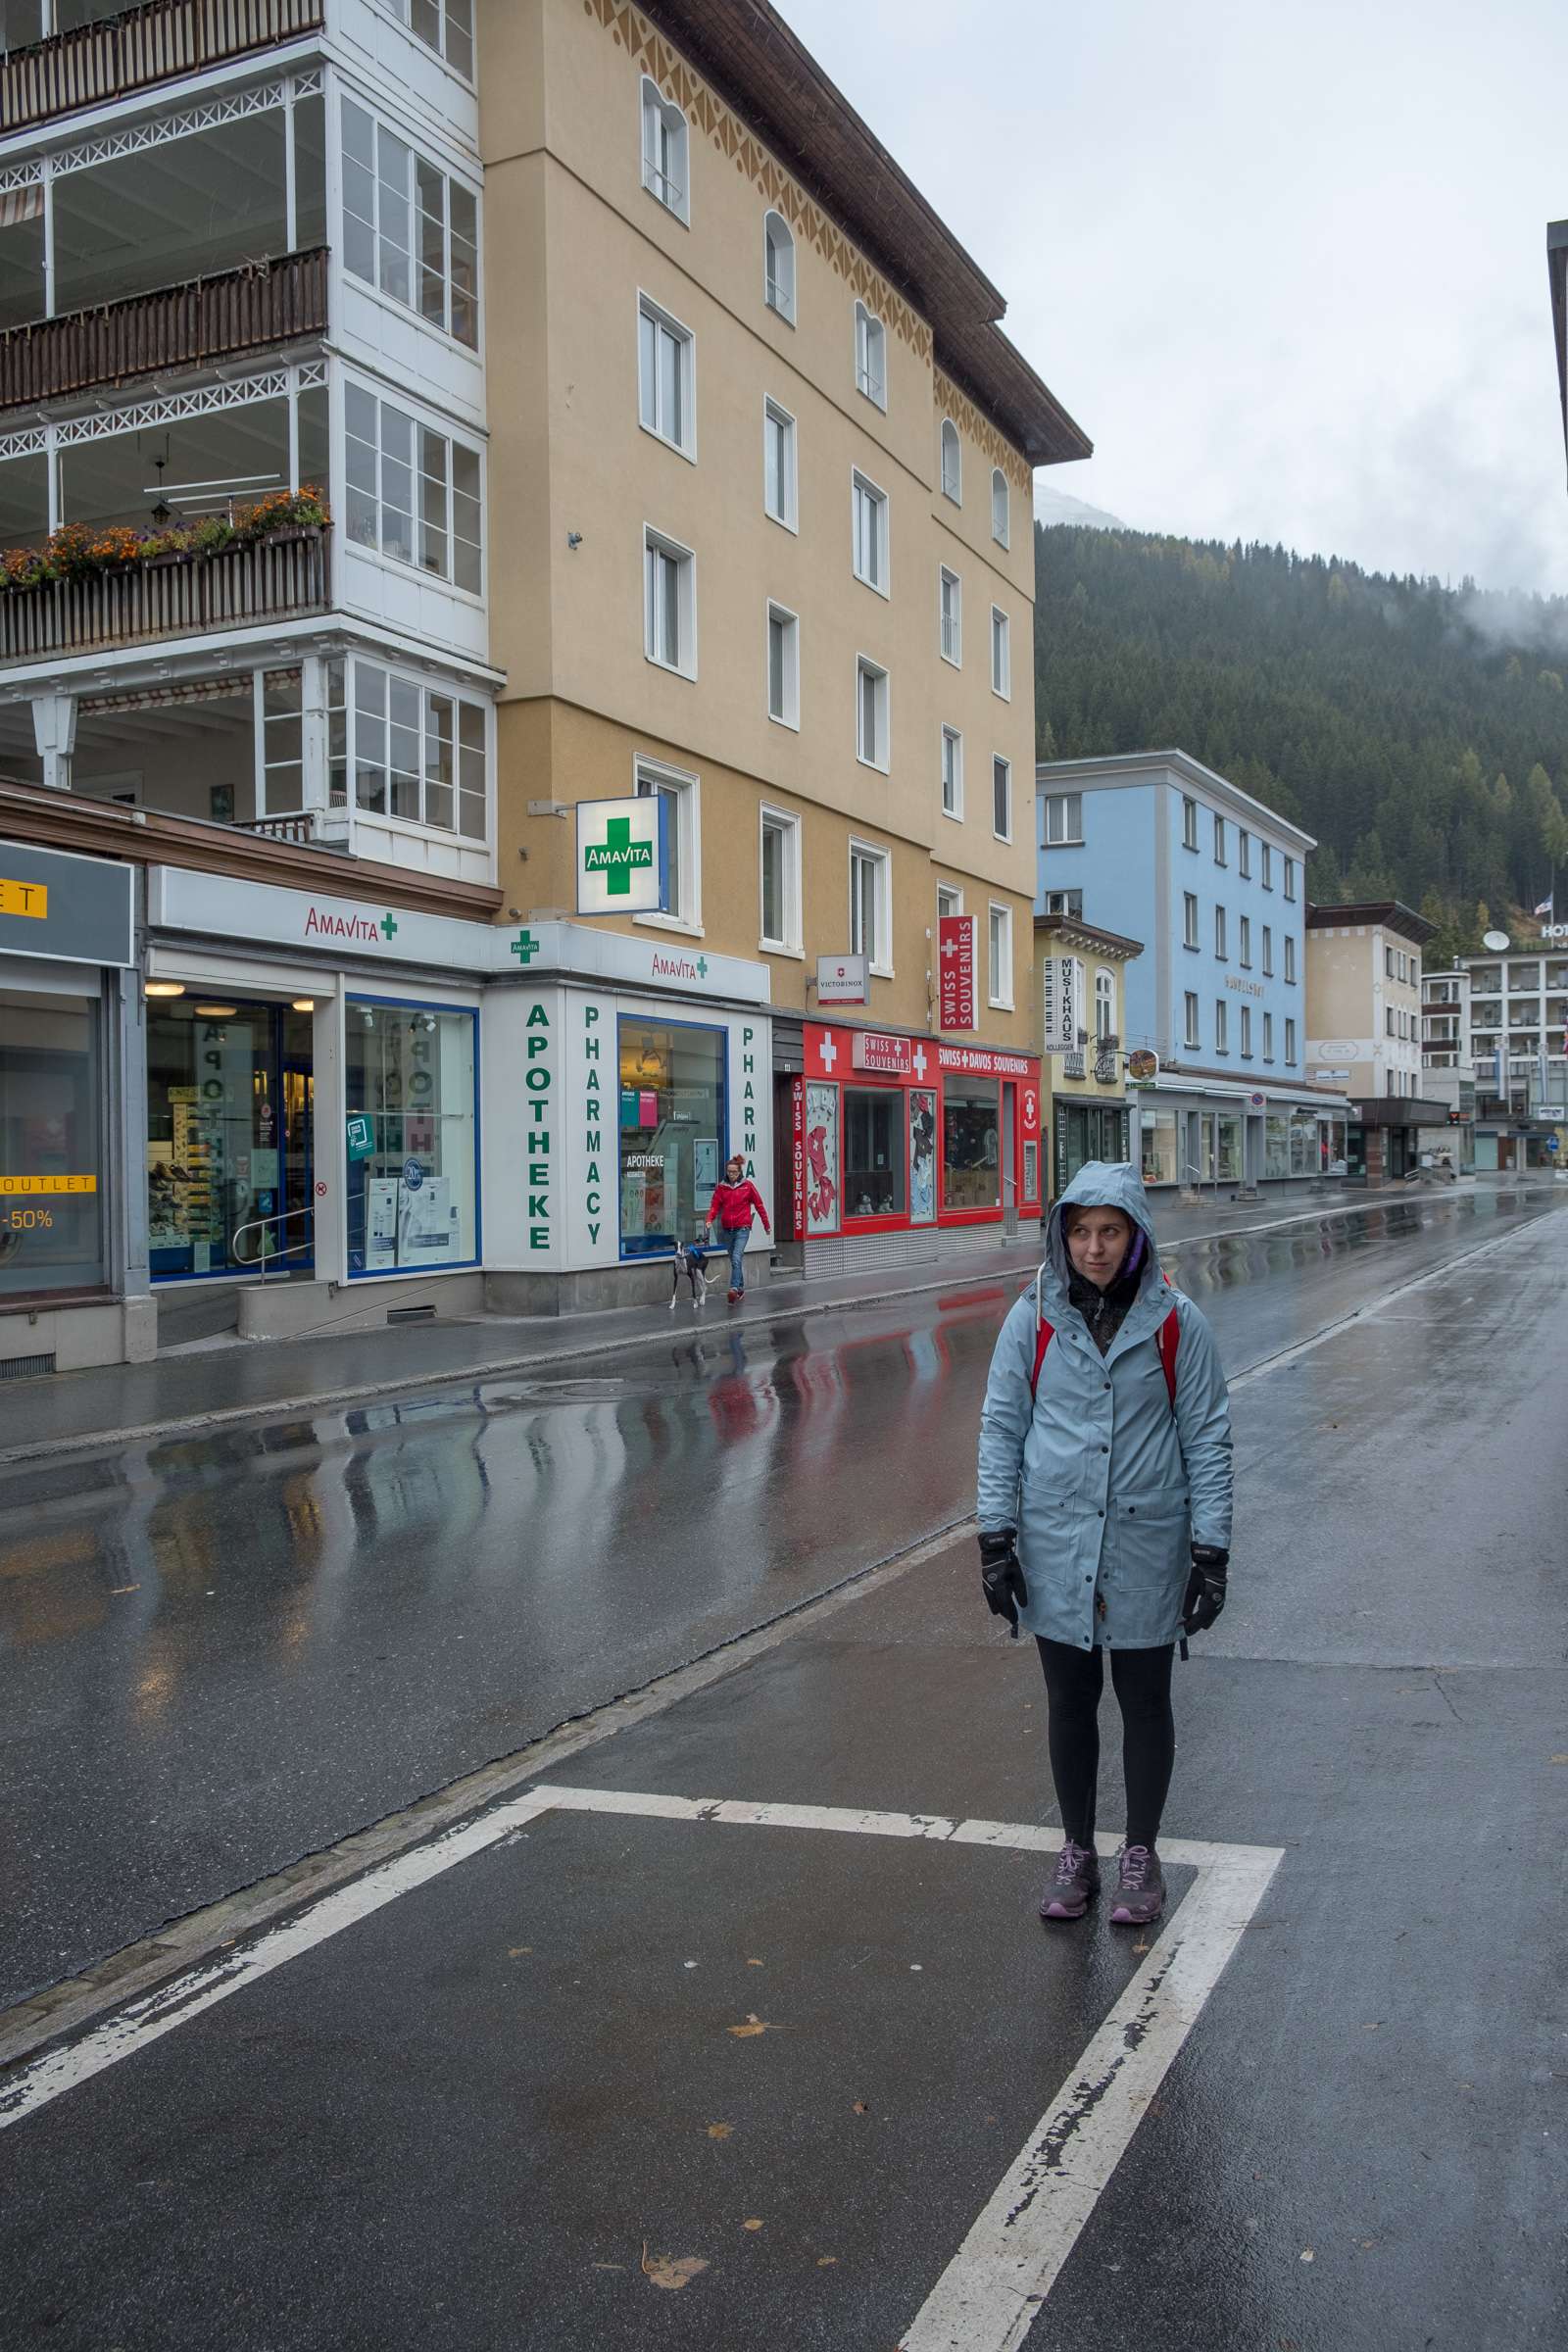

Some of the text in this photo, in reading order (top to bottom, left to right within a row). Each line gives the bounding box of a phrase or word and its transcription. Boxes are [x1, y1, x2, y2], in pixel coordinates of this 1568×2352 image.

[0, 884, 35, 910] T
[959, 921, 971, 1024] SOUVENIRS
[944, 971, 956, 1025] SWISS
[1061, 958, 1071, 1041] MUSIKHAUS
[865, 1037, 889, 1053] SWISS
[865, 1054, 909, 1070] SOUVENIRS
[939, 1048, 1028, 1075] SWISS DAVOS SOUVENIRS
[743, 1027, 756, 1179] PHARMA
[794, 1081, 803, 1131] SWISS
[525, 1004, 551, 1250] APOTHEKE
[585, 1005, 601, 1245] PHARMACY
[627, 1155, 664, 1167] APOTHEKE
[3, 1177, 90, 1192] OUTLET
[2, 1209, 53, 1229] -50%
